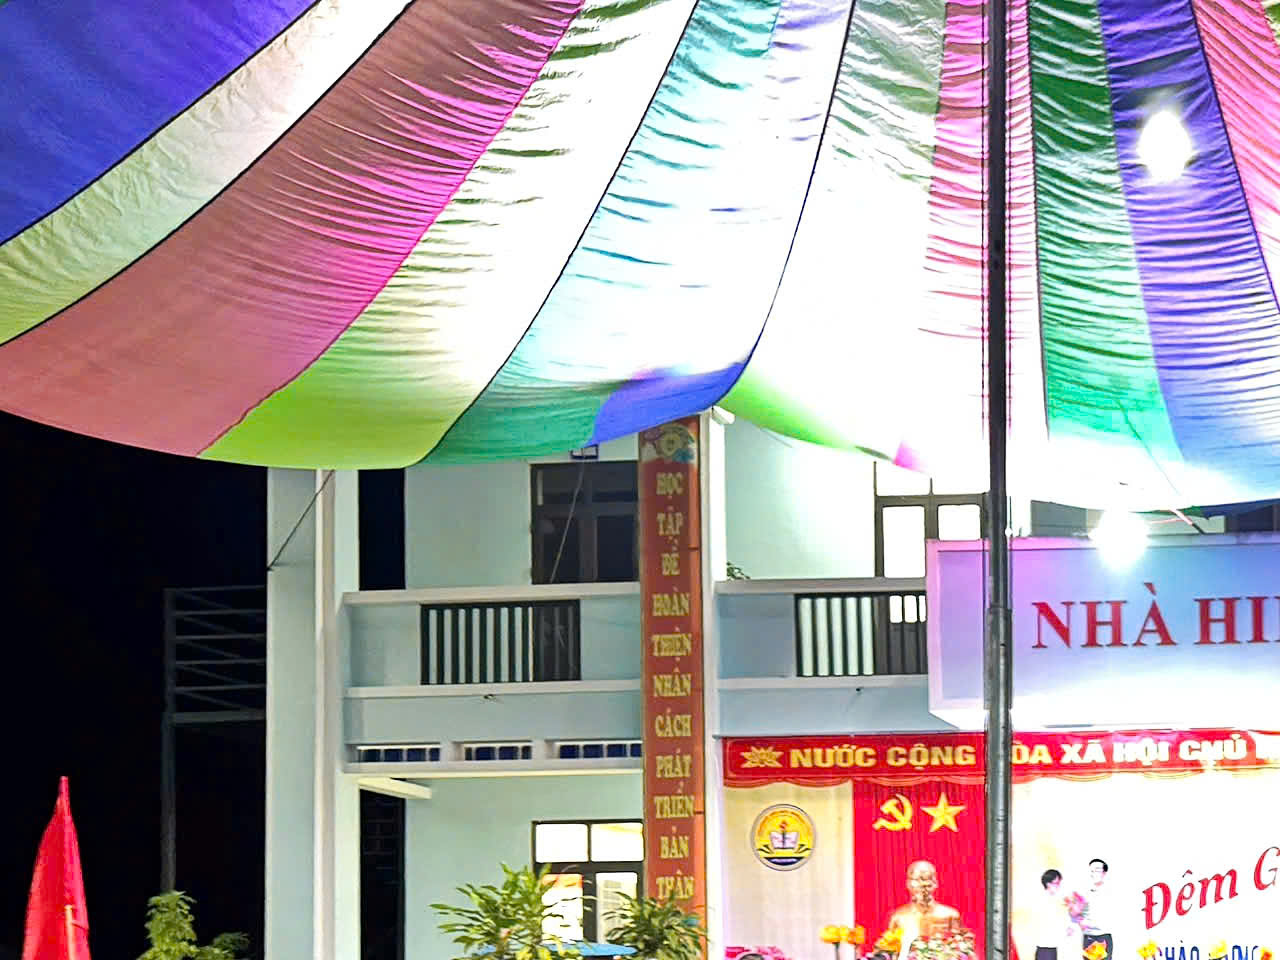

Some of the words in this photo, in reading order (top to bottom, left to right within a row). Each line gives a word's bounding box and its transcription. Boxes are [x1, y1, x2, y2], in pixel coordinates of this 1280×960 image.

[656, 472, 684, 499] HỌC
[652, 586, 690, 617] HOÀN
[1031, 582, 1179, 650] NHÀ
[651, 626, 692, 662] THIỆN
[653, 667, 691, 697] NHÂN
[655, 707, 692, 737] CÁCH
[656, 748, 691, 778] PHÁT
[790, 743, 876, 768] NƯỚC
[887, 743, 977, 770] CỘNG
[1011, 740, 1053, 764] ÒA
[1061, 739, 1106, 764] XÃ
[1112, 737, 1170, 766] HỘI
[1179, 733, 1248, 762] CHỦ
[653, 781, 694, 819] TRIỂN
[660, 826, 688, 859] BẢN
[656, 869, 694, 900] THÂN
[1141, 868, 1239, 930] Đêm
